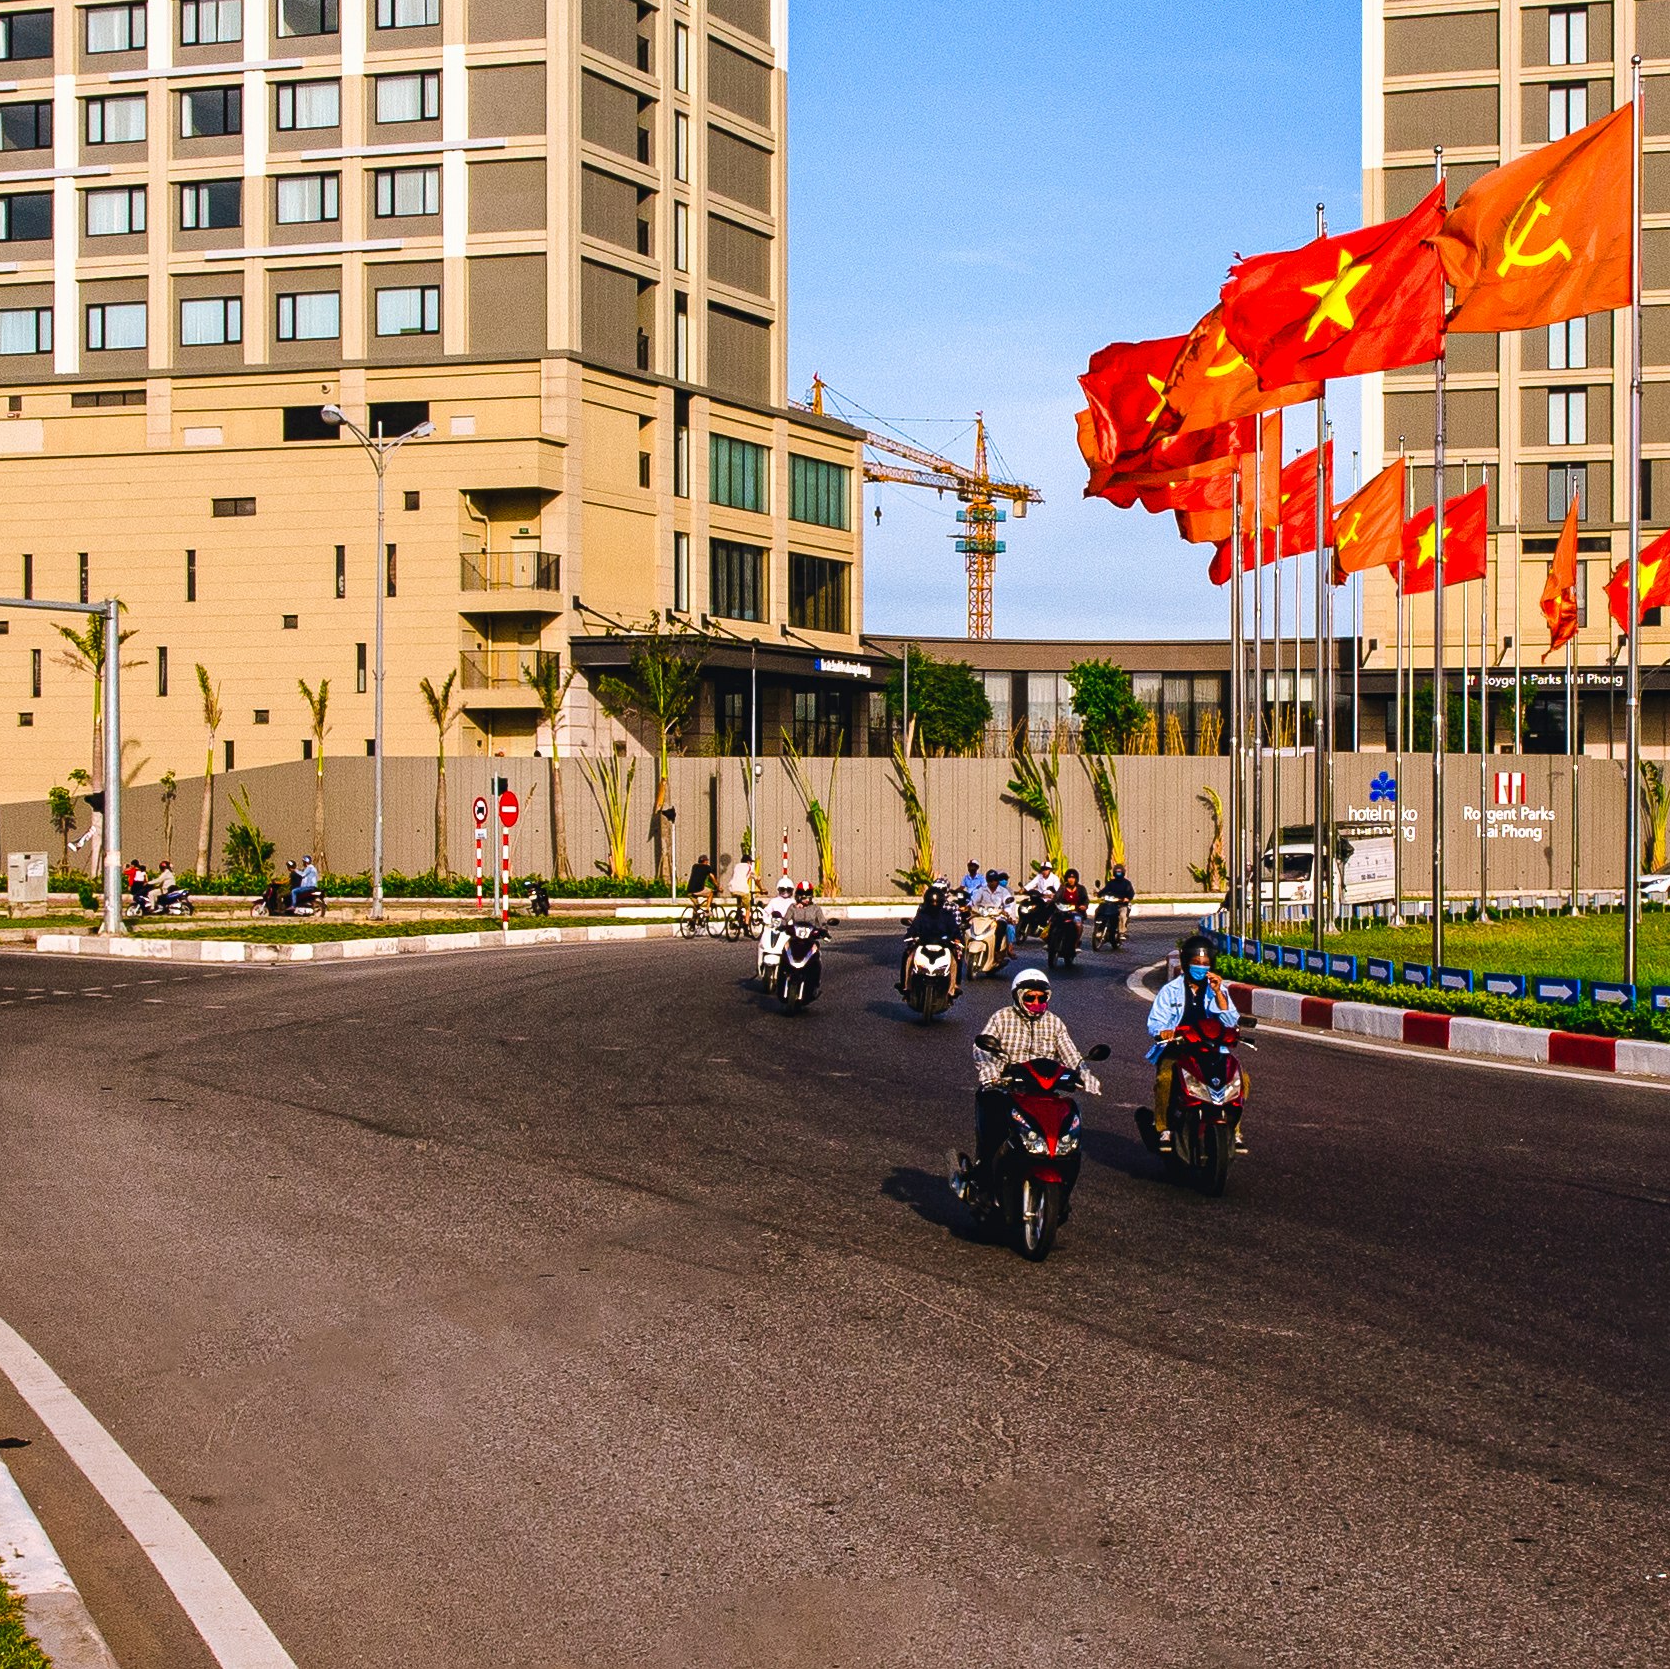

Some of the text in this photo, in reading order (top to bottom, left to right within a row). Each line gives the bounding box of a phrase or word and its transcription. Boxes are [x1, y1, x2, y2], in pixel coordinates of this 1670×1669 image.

[1483, 675, 1528, 688] oyget
[1530, 674, 1562, 685] Parks
[1348, 805, 1418, 822] hotel niko
[1520, 805, 1556, 821] Parks
[1501, 824, 1543, 842] Phong
